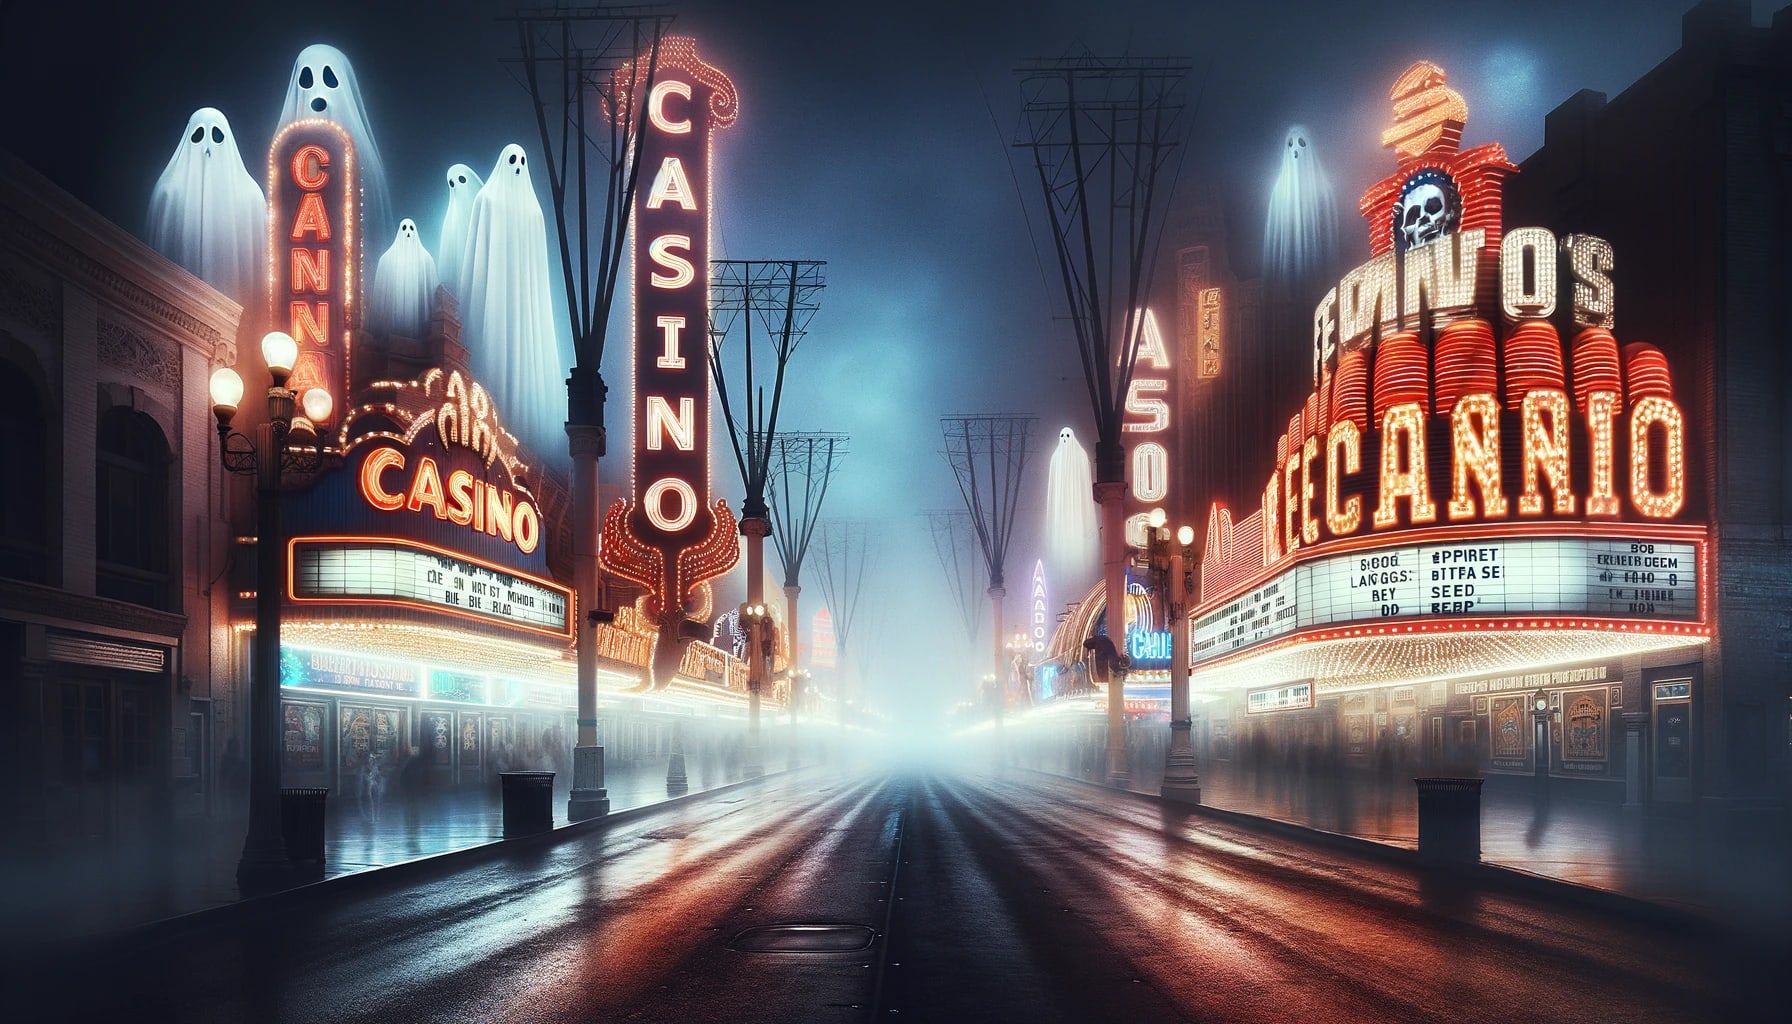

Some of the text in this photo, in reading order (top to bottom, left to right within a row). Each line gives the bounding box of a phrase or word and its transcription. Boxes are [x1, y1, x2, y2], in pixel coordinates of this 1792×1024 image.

[644, 79, 698, 532] CASINO
[360, 446, 540, 555] CASINO
[1630, 544, 1655, 554] BOB
[1431, 584, 1475, 599] SEED
